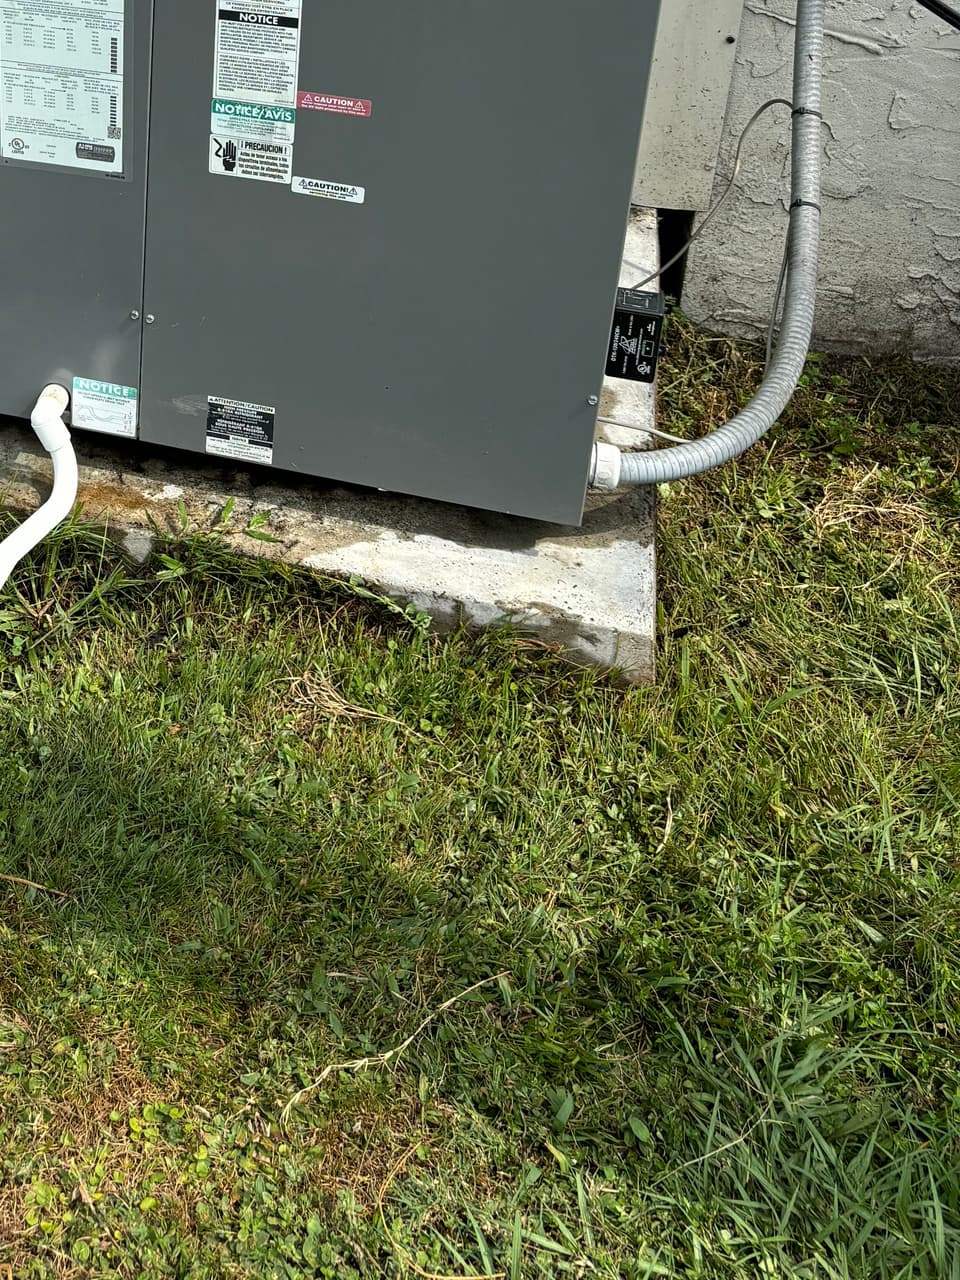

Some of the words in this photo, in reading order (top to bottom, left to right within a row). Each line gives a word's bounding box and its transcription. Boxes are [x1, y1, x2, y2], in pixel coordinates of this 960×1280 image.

[239, 13, 279, 26] NOTICE
[314, 96, 353, 106] CAUTION
[216, 103, 292, 122] NOTICE/AVIS
[308, 181, 349, 193] CAUTION!
[80, 380, 128, 397] NOTICE
